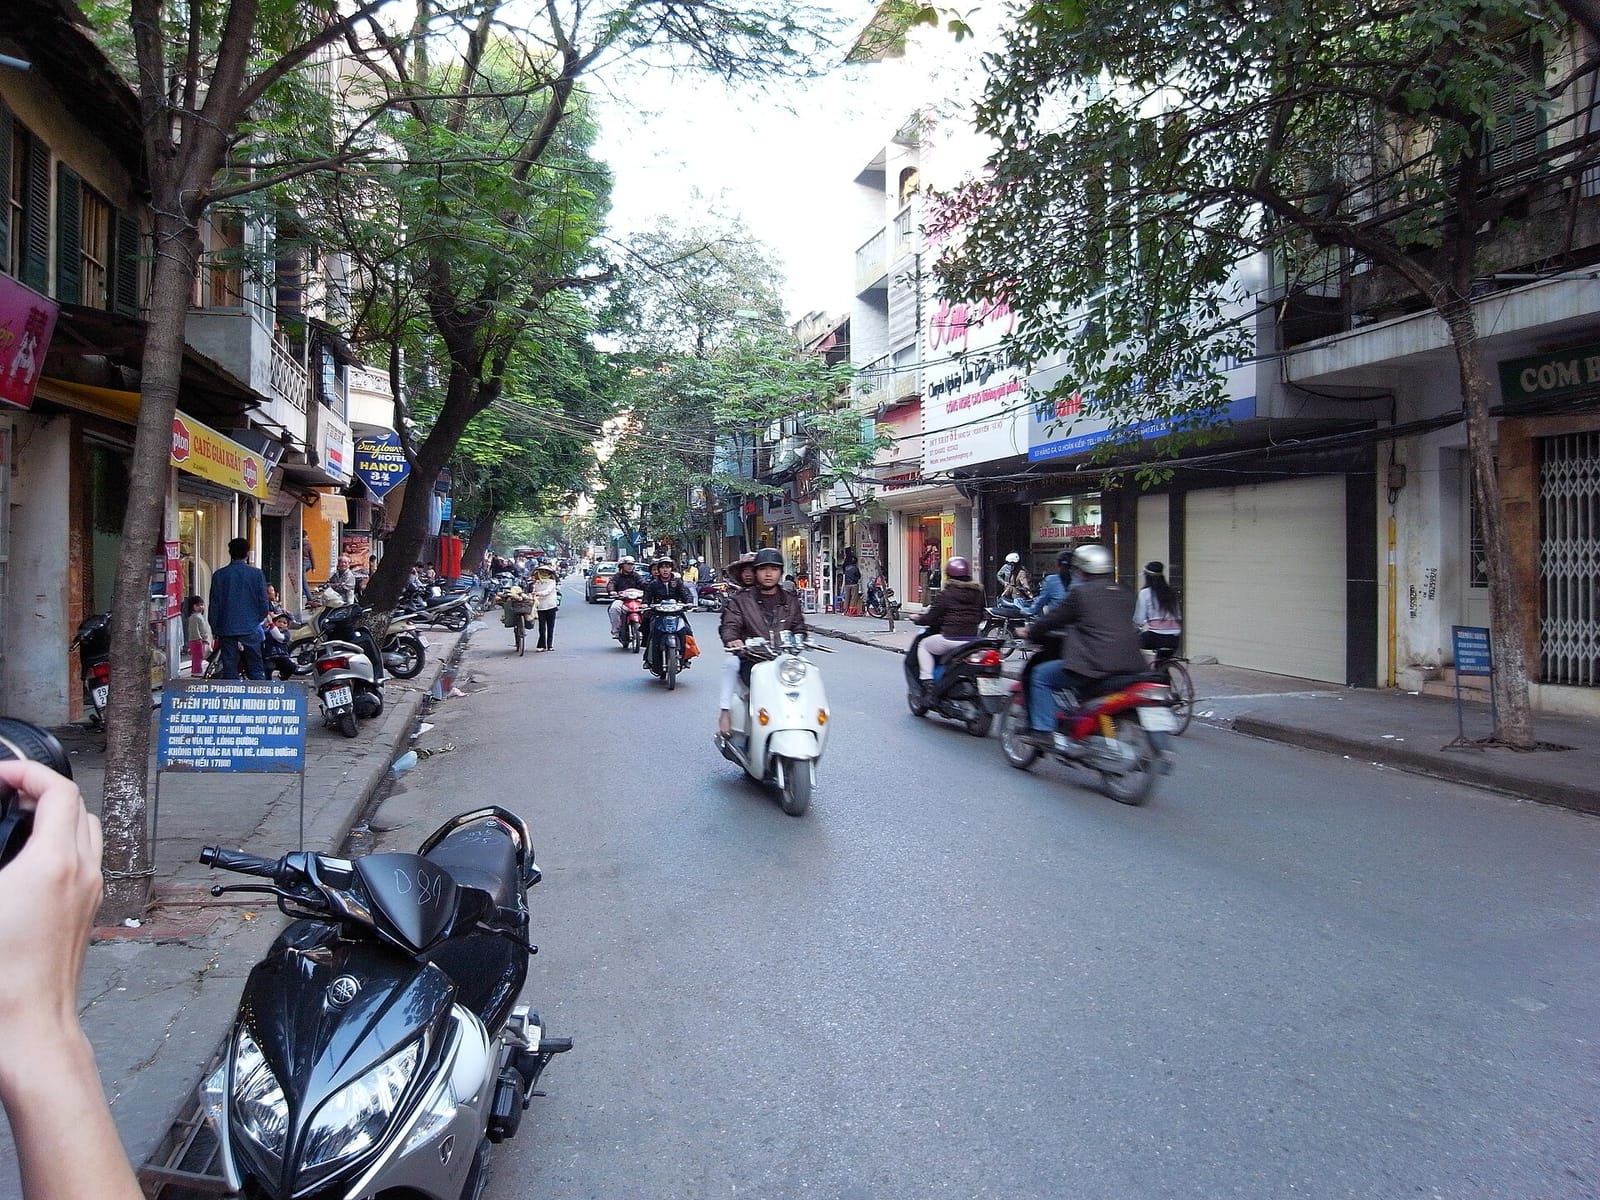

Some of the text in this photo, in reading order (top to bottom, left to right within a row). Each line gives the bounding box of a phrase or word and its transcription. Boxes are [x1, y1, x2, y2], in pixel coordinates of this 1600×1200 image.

[1520, 360, 1581, 392] CƠM
[173, 432, 189, 452] pton
[194, 436, 211, 459] CAFÉ
[360, 462, 403, 473] HANOI
[378, 454, 406, 462] HOTEL
[371, 472, 390, 481] 34
[202, 694, 222, 709] PHỐ
[222, 696, 241, 710] VĂN
[242, 698, 266, 710] MINH
[281, 698, 296, 713] THỊ
